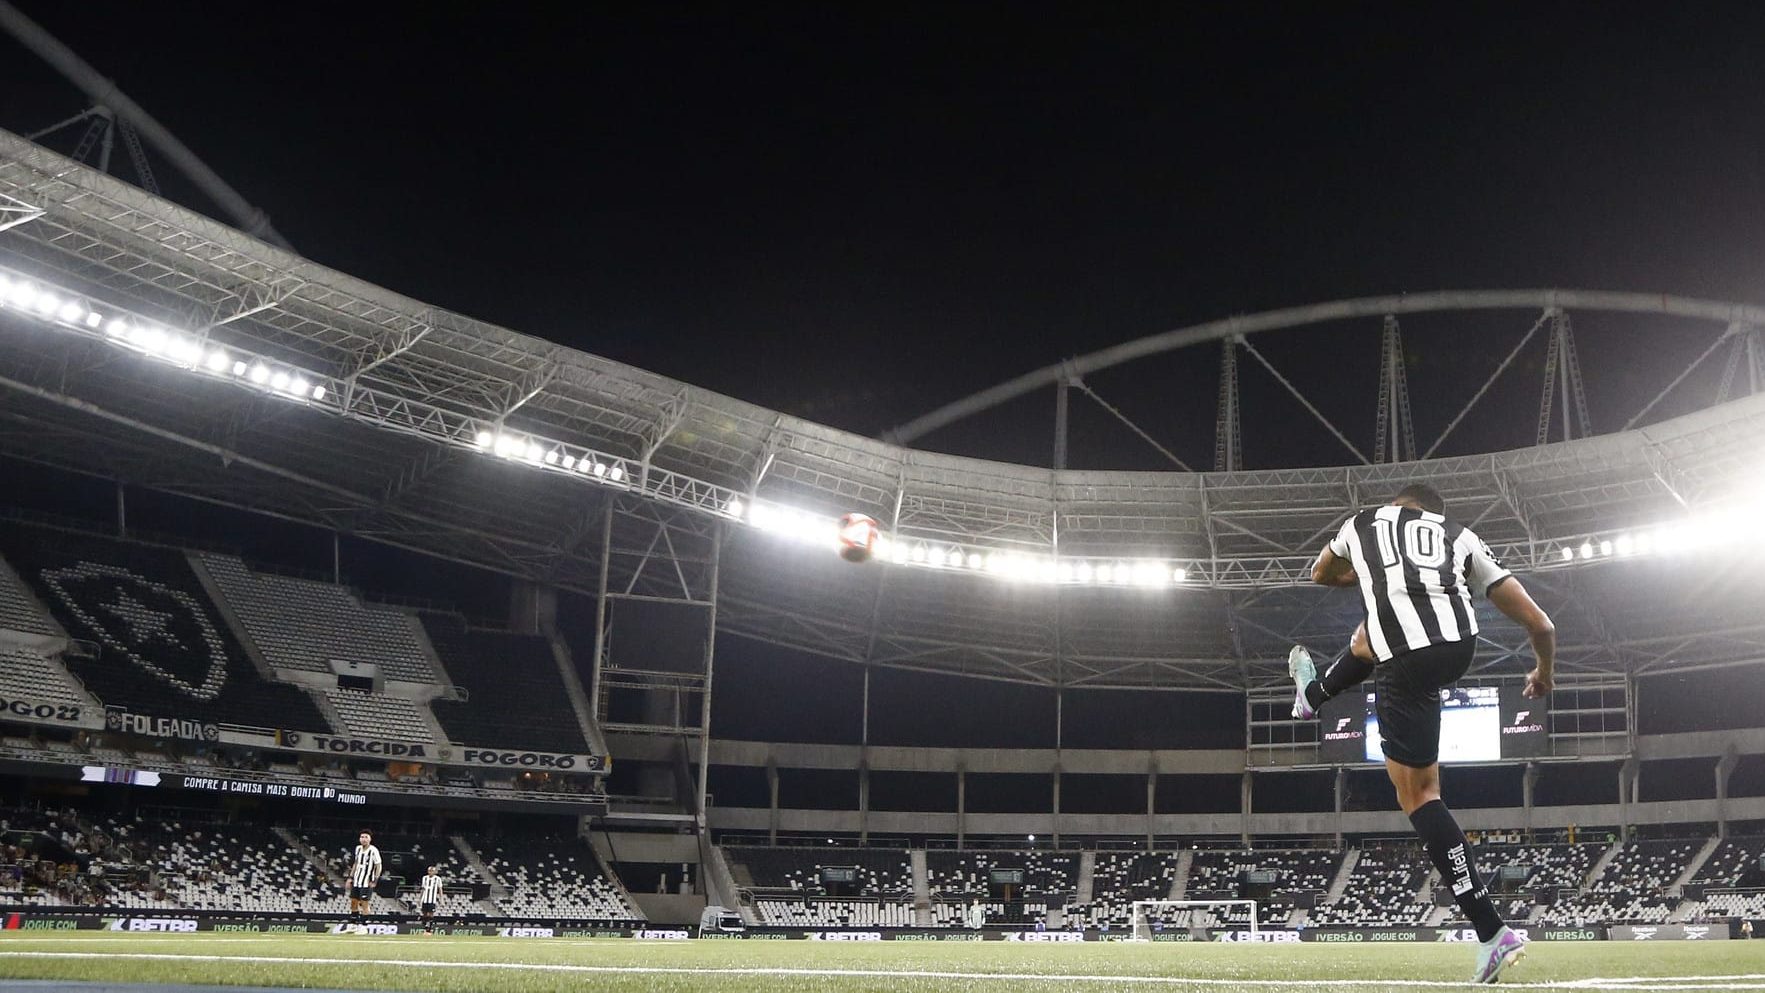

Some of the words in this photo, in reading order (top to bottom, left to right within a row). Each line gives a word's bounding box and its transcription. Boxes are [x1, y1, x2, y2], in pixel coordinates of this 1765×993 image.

[1371, 518, 1446, 568] 10
[121, 713, 205, 741] FOLGADA
[313, 736, 426, 757] TORCIDA
[184, 777, 218, 790] COMPRE
[221, 781, 228, 790] A
[231, 781, 262, 793] CAMISA
[266, 784, 287, 796] MAIS
[291, 786, 320, 798] BONITA
[324, 787, 335, 798] DO
[338, 793, 366, 804] MUNDO
[1316, 931, 1363, 942] IVERSÃO
[1371, 933, 1396, 941] JOGUE
[1398, 932, 1416, 941] COM
[1435, 930, 1459, 942] 7K
[1545, 929, 1594, 940] IVERSÃO
